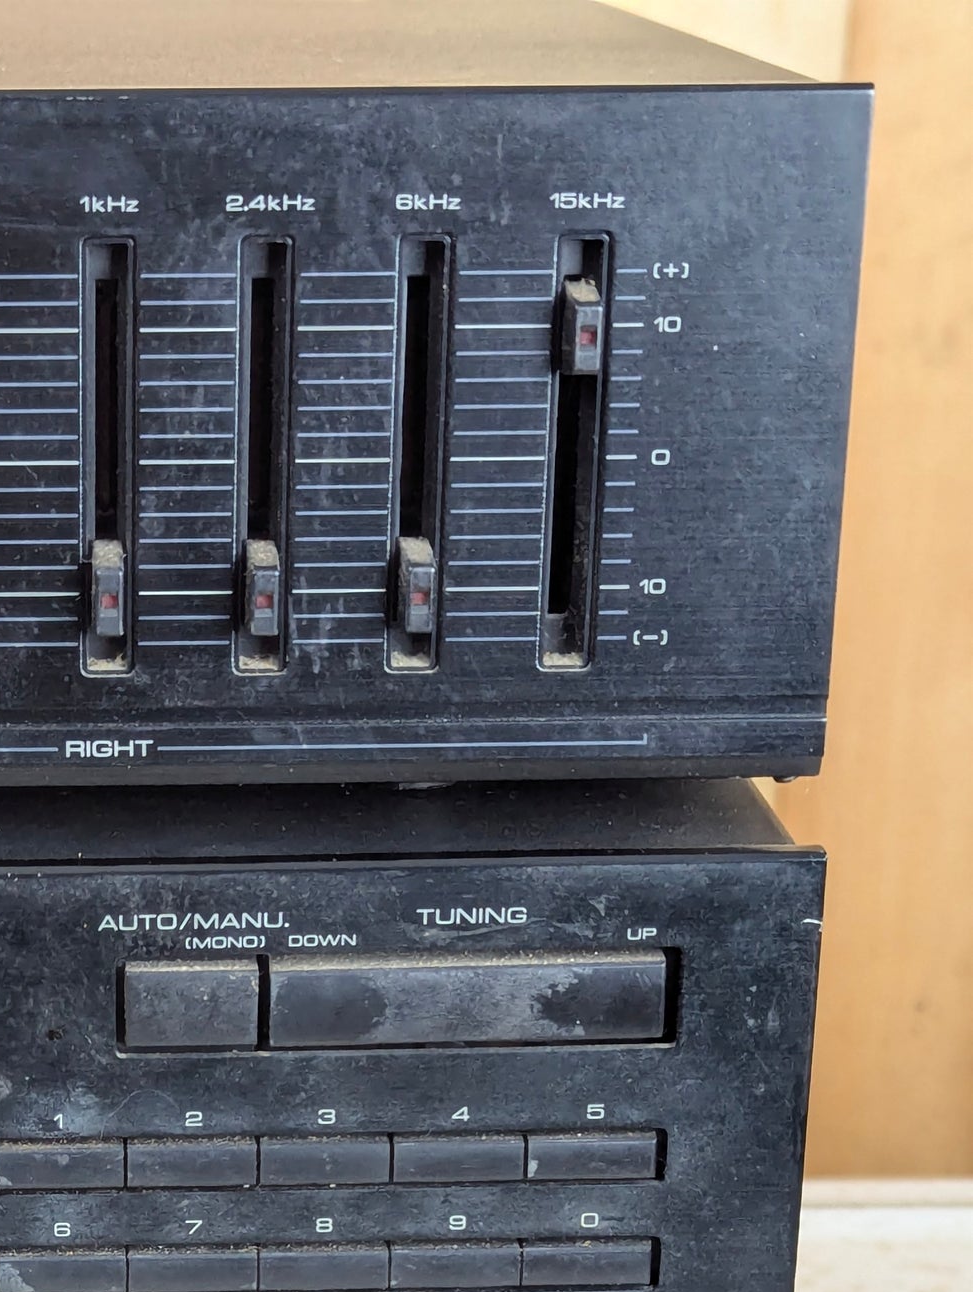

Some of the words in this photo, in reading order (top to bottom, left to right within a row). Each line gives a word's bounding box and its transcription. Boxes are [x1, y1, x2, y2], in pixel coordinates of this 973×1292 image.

[80, 196, 139, 212] 1kHz
[226, 195, 315, 211] 2.4kHz
[396, 194, 461, 210] 6kHz
[550, 193, 624, 208] 15kHz
[654, 317, 681, 332] 10
[652, 449, 670, 465] 0
[640, 579, 666, 594] 10
[66, 740, 153, 757] RIGHT
[98, 912, 289, 931] AUTO/MANU.
[416, 907, 527, 924] TUNING
[289, 934, 356, 946] DOWN
[627, 928, 656, 940] UP
[186, 936, 265, 949] (MONO)
[186, 1112, 202, 1126] 2
[318, 1109, 335, 1124] 3
[452, 1107, 469, 1121] 4
[587, 1104, 604, 1119] 5
[54, 1114, 62, 1129] 1
[186, 1220, 202, 1234] 7
[316, 1218, 332, 1232] 8
[449, 1215, 466, 1230] 9
[581, 1213, 598, 1227] 0
[54, 1223, 70, 1236] 6
